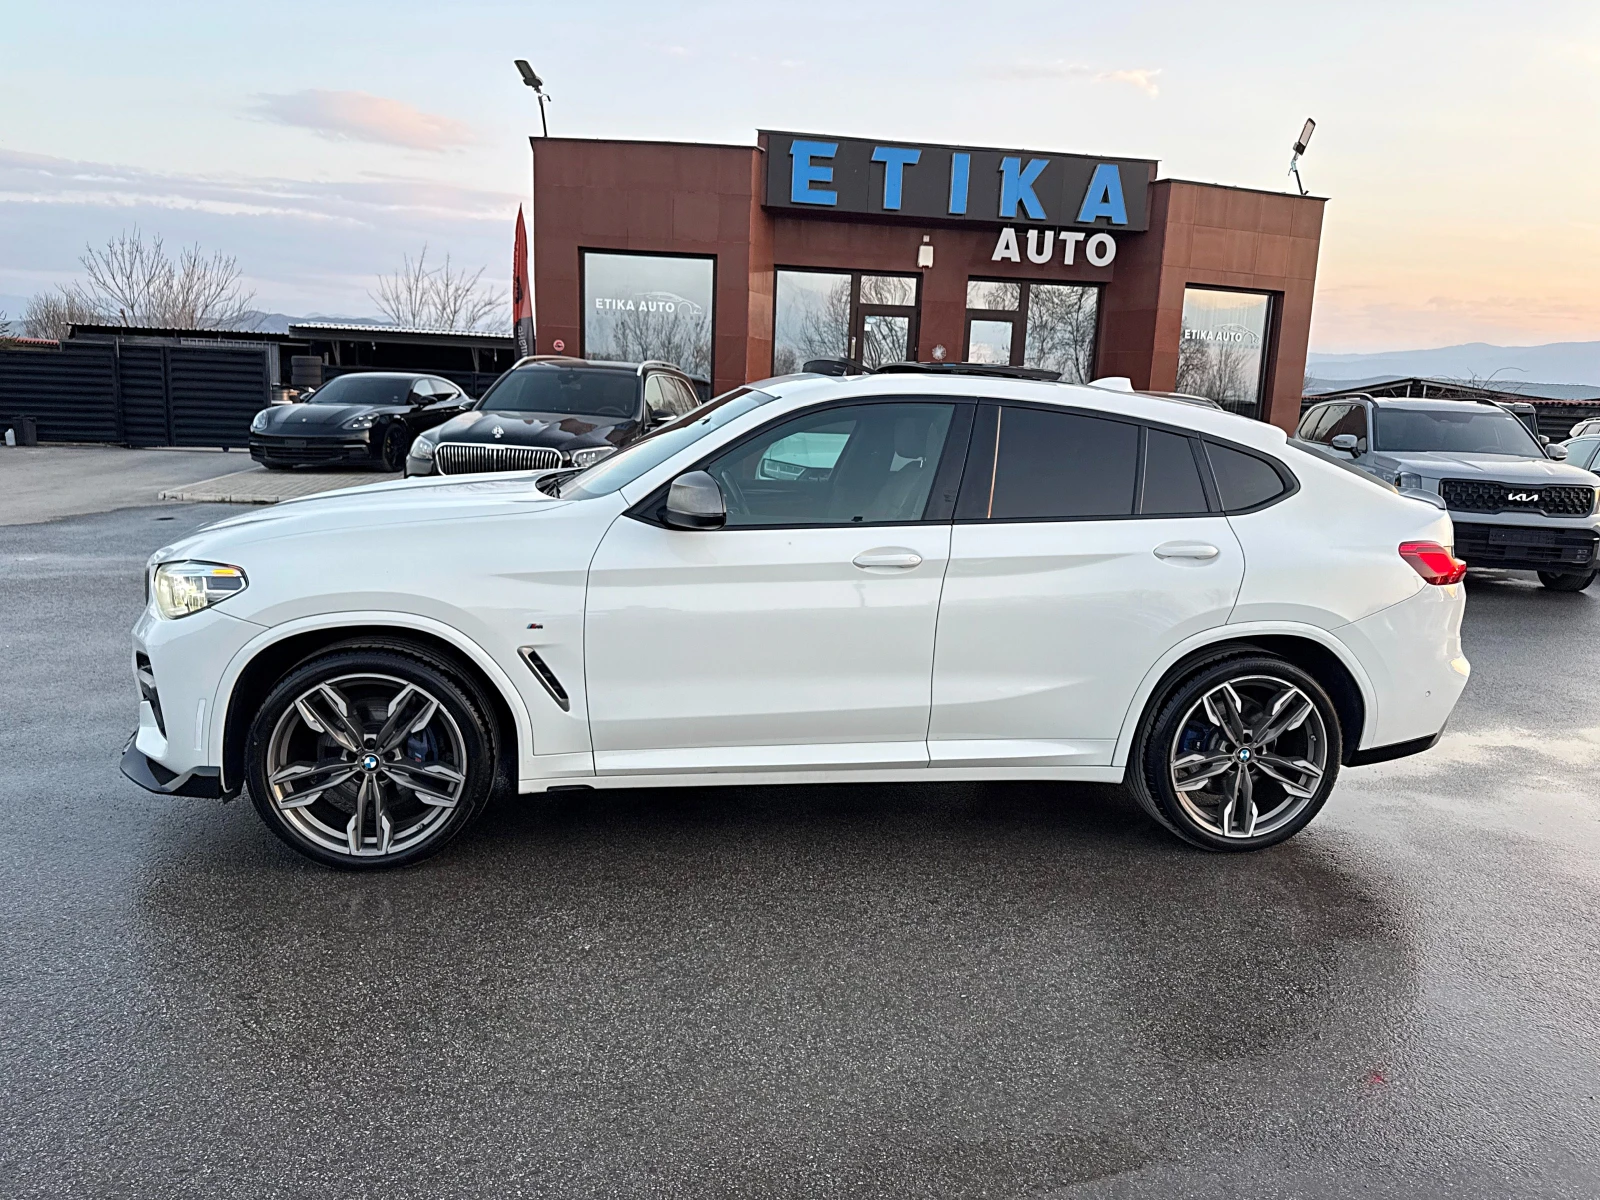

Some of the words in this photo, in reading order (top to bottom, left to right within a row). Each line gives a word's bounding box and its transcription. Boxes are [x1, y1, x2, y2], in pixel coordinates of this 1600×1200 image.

[789, 140, 1129, 225] ETIKA
[991, 227, 1117, 267] AUTO
[595, 298, 635, 311] ETIKA
[638, 300, 675, 313] AUTO
[1184, 329, 1213, 341] ETIKA
[1215, 331, 1242, 342] AUTO
